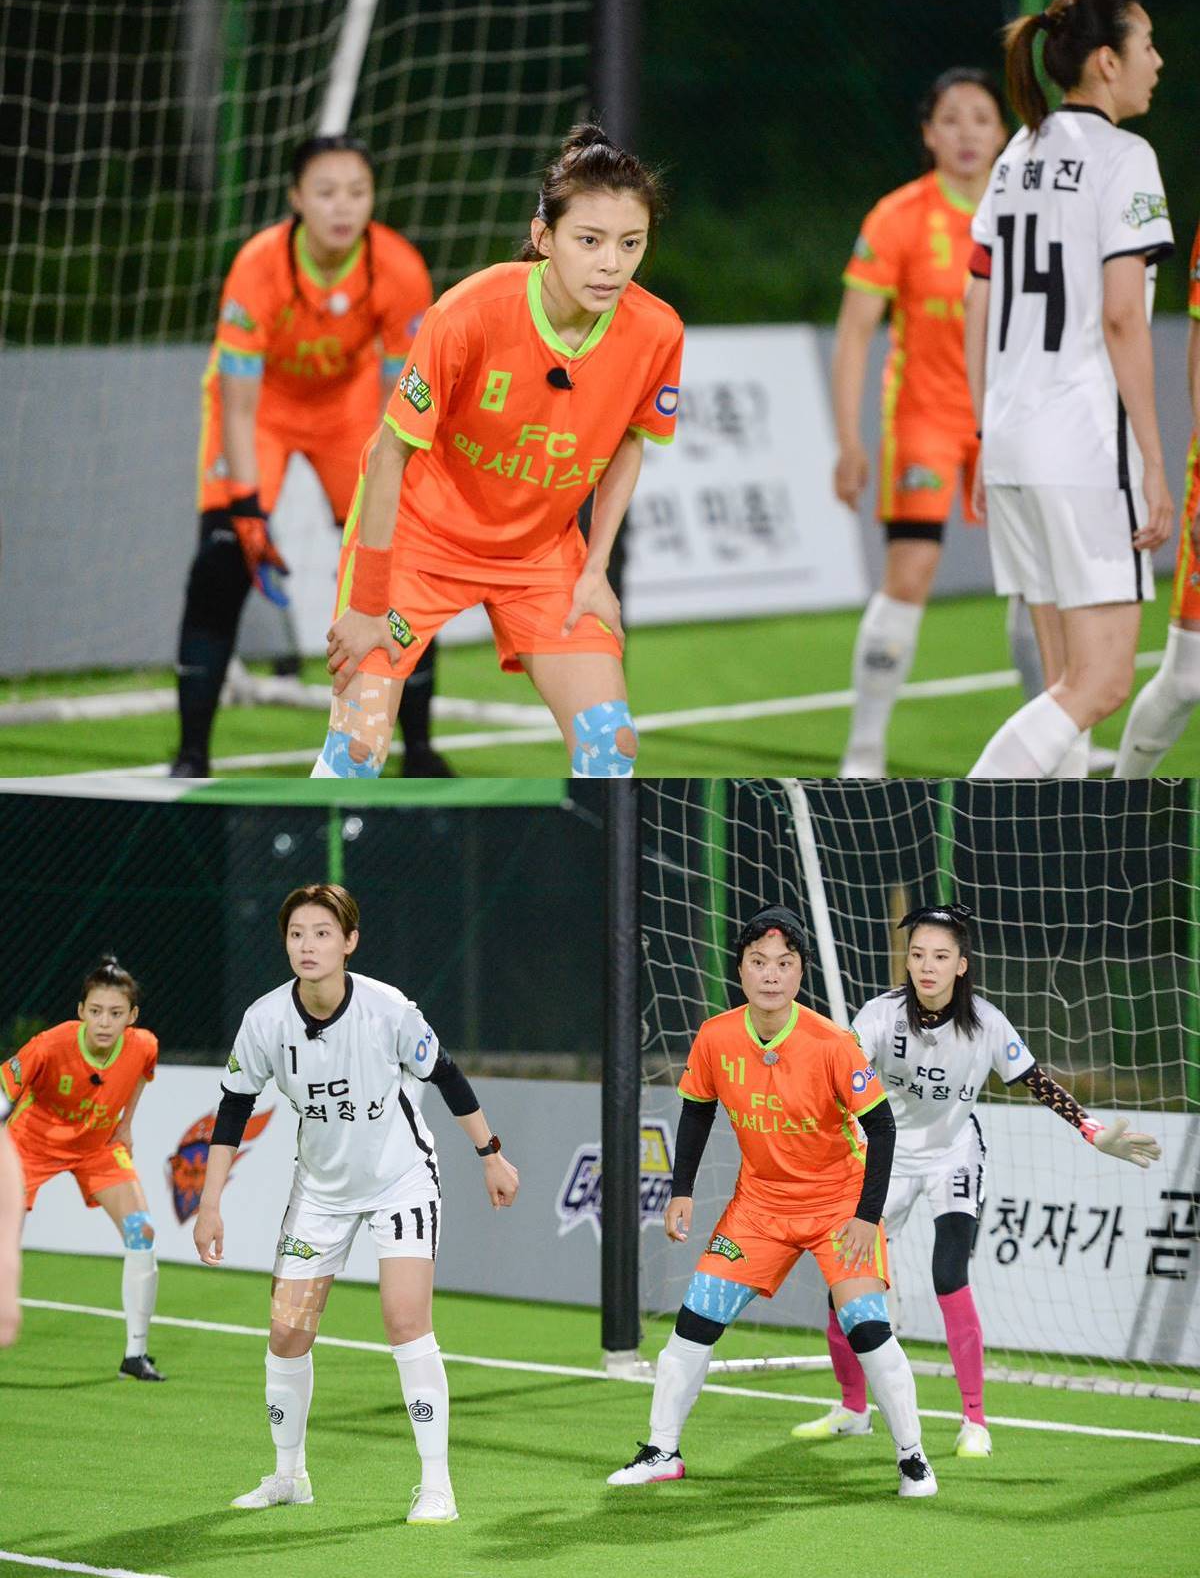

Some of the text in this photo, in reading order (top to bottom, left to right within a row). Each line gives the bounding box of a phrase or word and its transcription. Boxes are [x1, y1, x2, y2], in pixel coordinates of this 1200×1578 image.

[996, 212, 1067, 353] 14
[480, 369, 513, 413] 8
[517, 423, 578, 459] FC
[894, 1035, 908, 1060] 3
[720, 1053, 746, 1086] 41
[916, 1066, 946, 1082] FC
[59, 1074, 74, 1096] 8
[307, 1078, 350, 1100] FC
[291, 1097, 385, 1123] 척장신
[751, 1092, 784, 1112] FC
[953, 1174, 970, 1199] 3
[390, 1207, 424, 1241] 11
[970, 1195, 1124, 1270] 청자가
